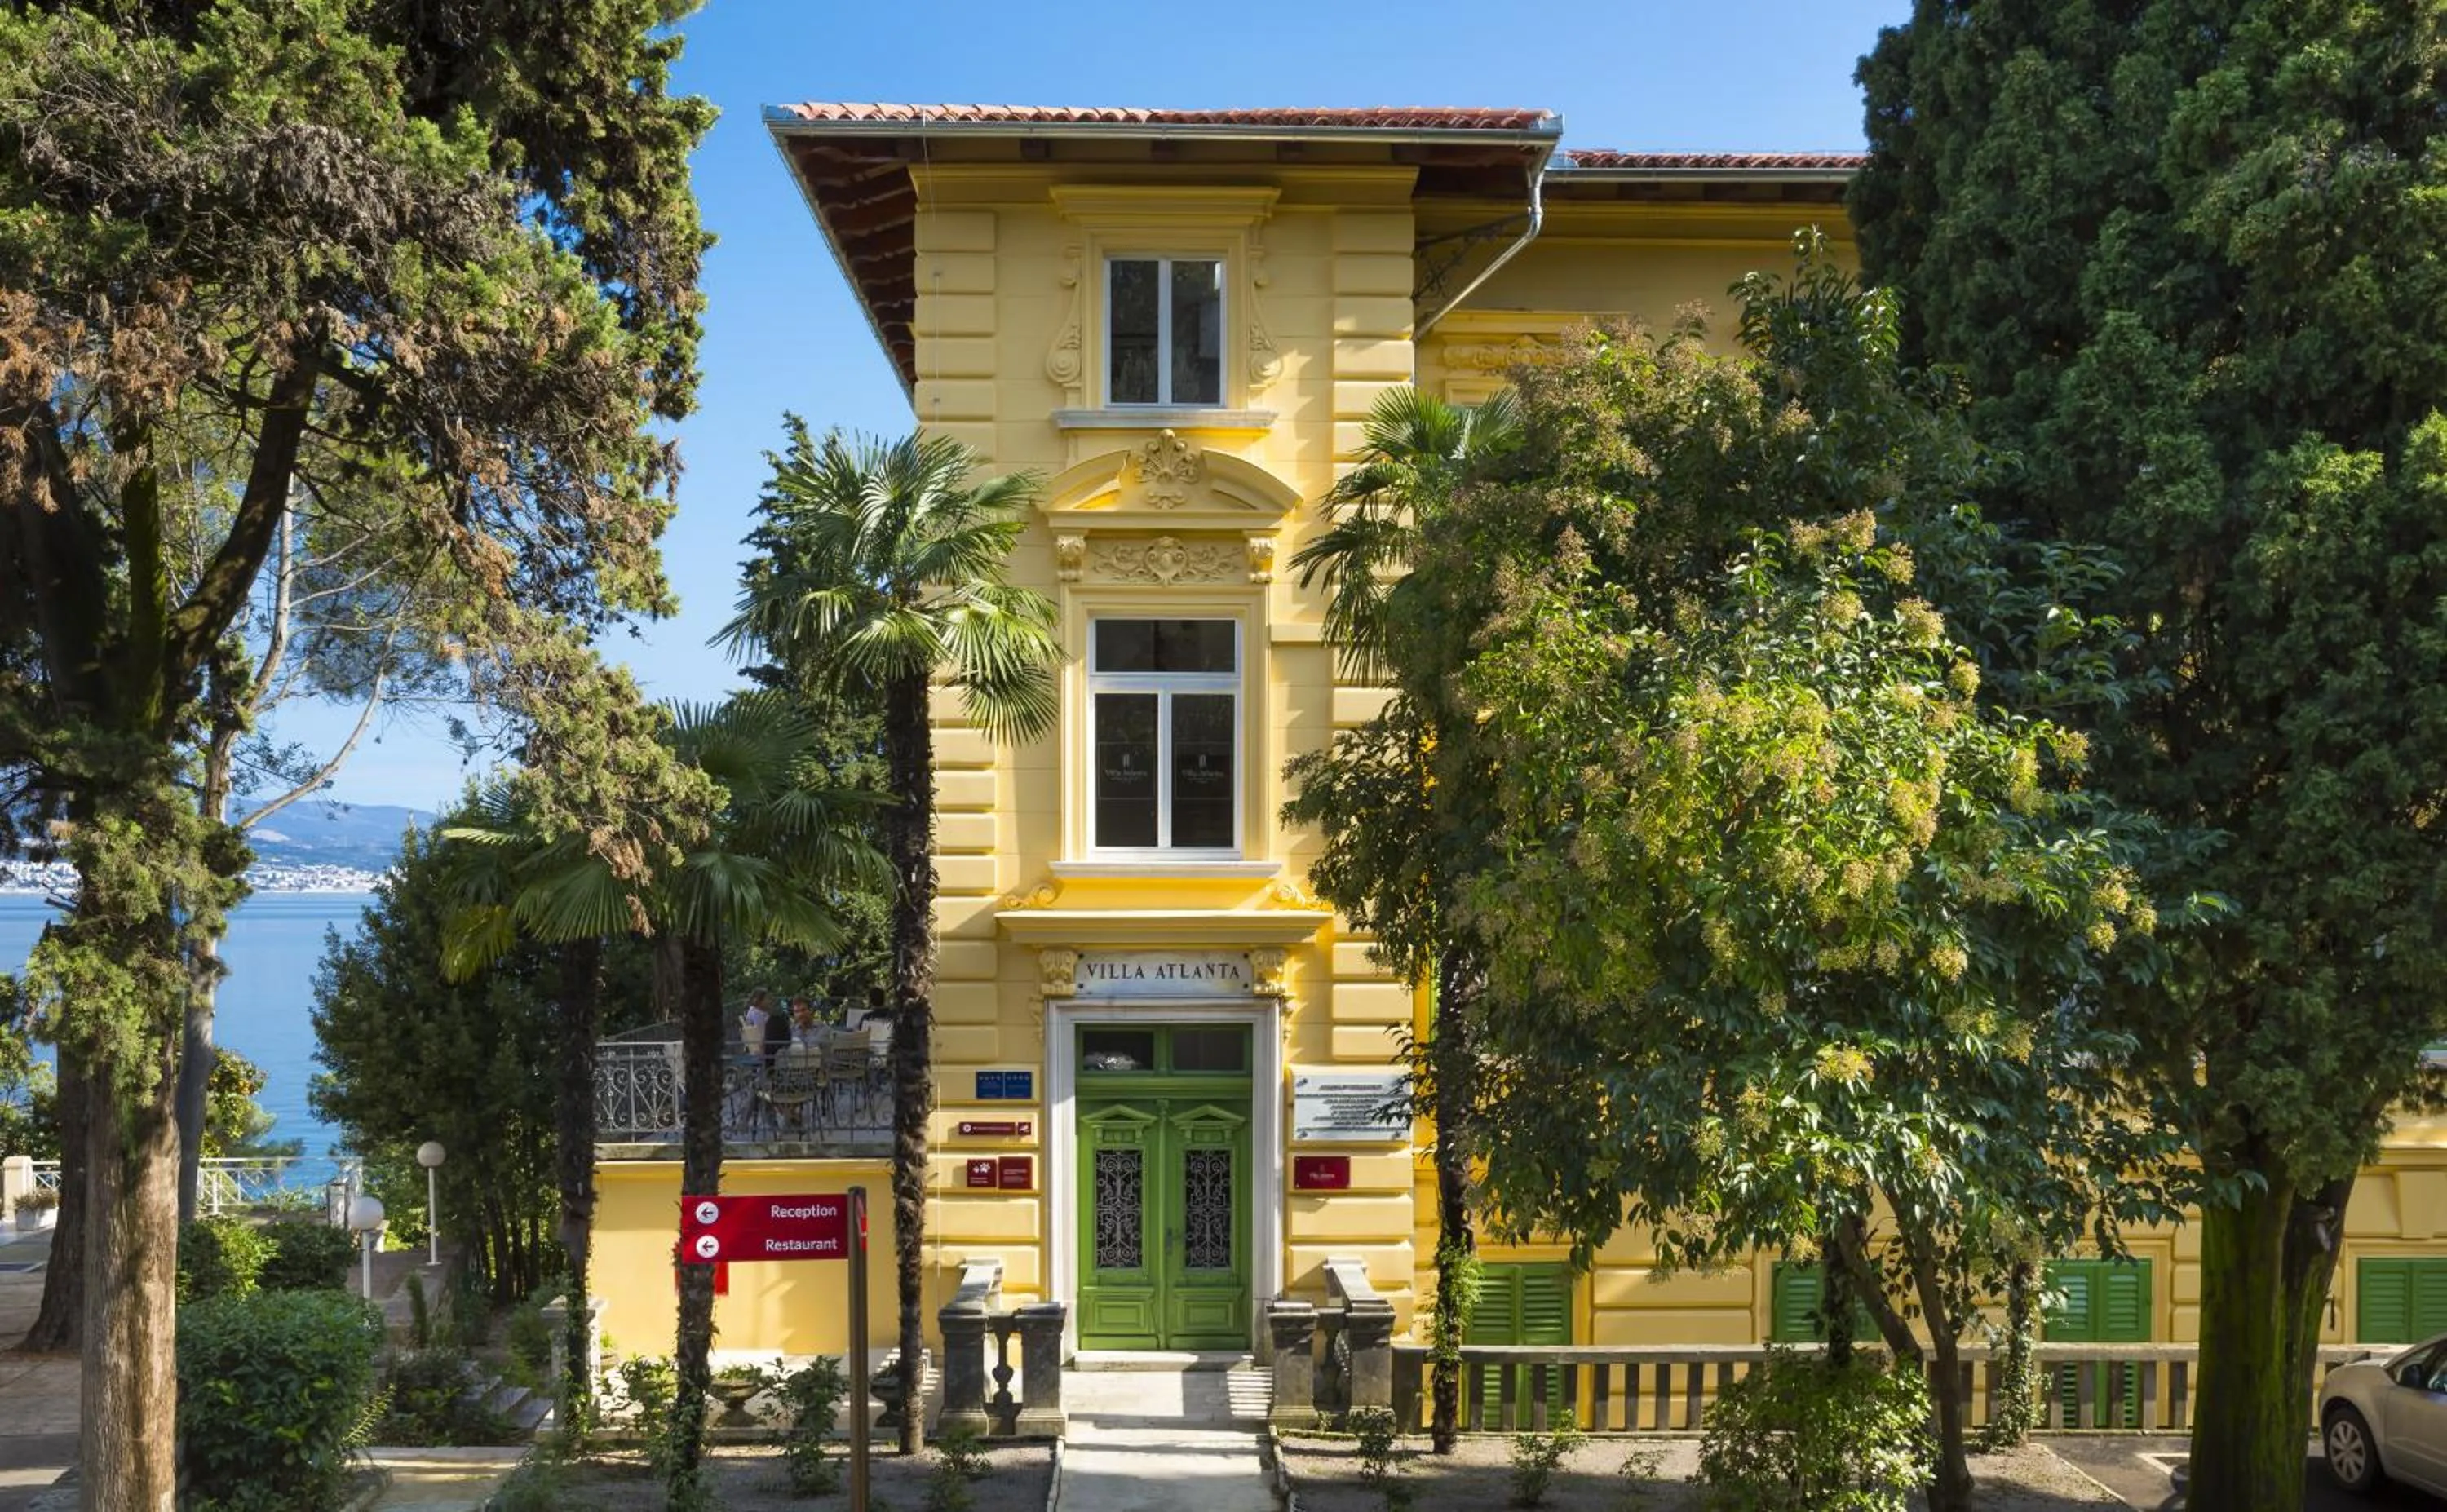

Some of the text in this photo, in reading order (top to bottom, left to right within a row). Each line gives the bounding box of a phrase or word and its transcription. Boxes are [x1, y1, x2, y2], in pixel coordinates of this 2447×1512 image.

[1086, 963, 1240, 979] VILLA ATLANTA
[770, 1204, 837, 1220] Reception
[765, 1237, 838, 1252] Restaurant
